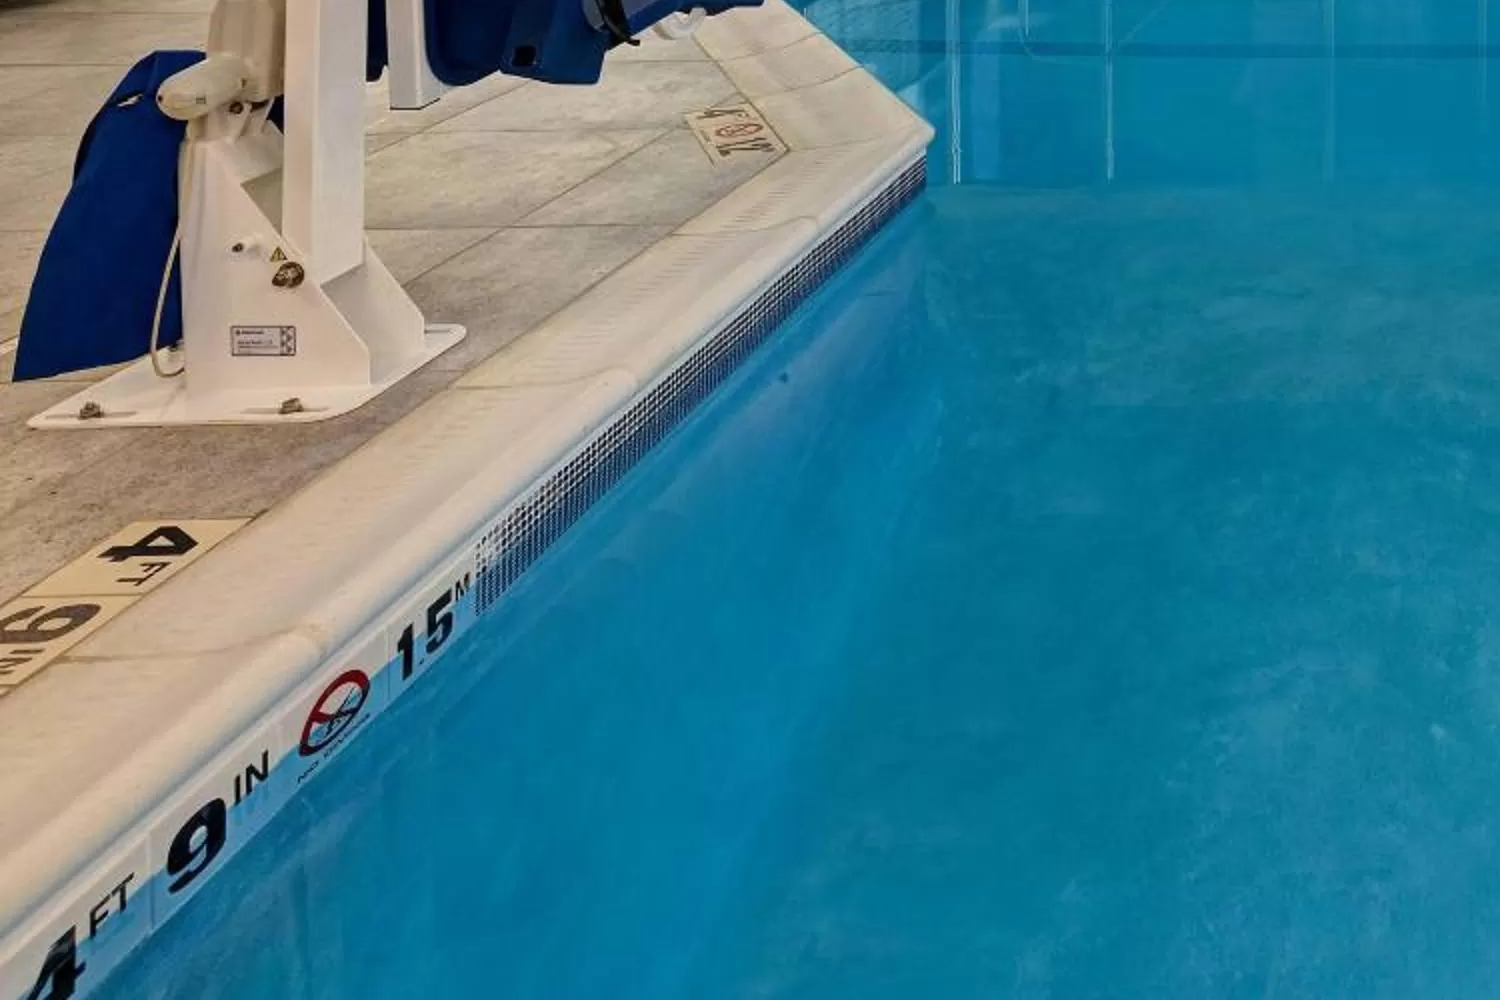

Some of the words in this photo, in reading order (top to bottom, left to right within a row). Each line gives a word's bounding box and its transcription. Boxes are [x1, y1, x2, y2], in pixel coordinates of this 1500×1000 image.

[96, 525, 199, 563] 4
[115, 561, 172, 587] FT
[89, 872, 135, 939] FT
[167, 797, 228, 895] 9
[233, 748, 269, 806] IN
